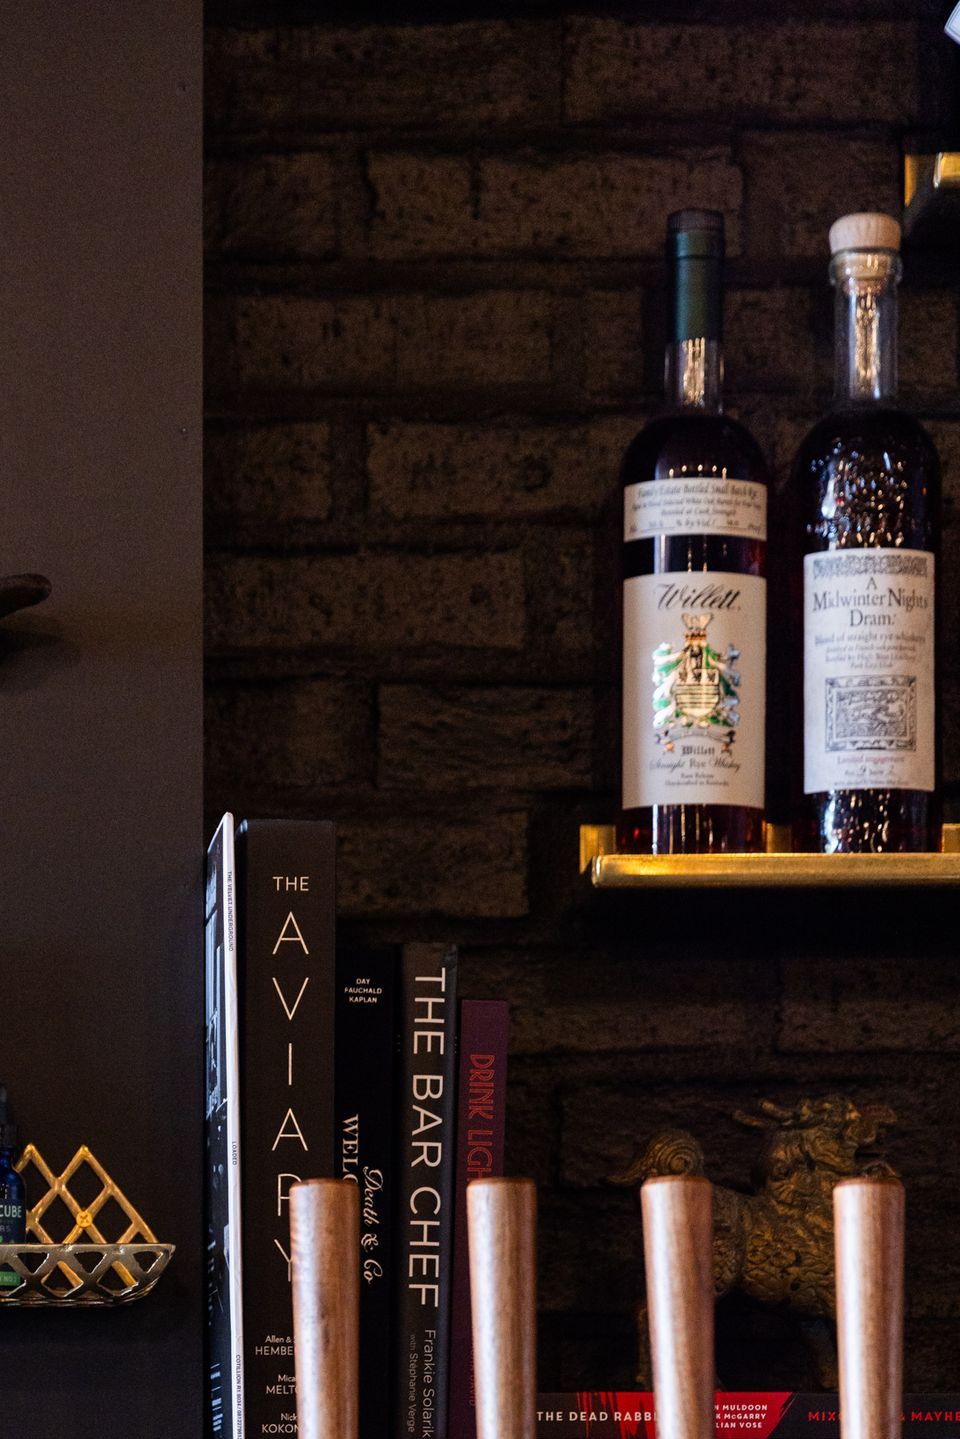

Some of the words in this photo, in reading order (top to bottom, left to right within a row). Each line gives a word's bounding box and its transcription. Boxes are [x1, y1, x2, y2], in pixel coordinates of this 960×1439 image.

[654, 583, 740, 611] Willett
[866, 577, 877, 590] A
[813, 589, 887, 612] Midwinter
[888, 587, 929, 613] Nights
[273, 876, 310, 892] THE
[344, 986, 383, 995] FAUCHALD
[348, 995, 378, 1004] KAPLAN
[413, 967, 446, 1055] THE
[468, 1053, 496, 1120] DRINK
[410, 1074, 444, 1168] BAR
[361, 1165, 384, 1226] Death
[360, 1232, 379, 1253] &
[407, 1186, 441, 1308] CHEF
[265, 1335, 285, 1343] Allen
[421, 1329, 437, 1384] Frankie
[407, 1404, 417, 1433] Verge
[421, 1389, 435, 1439] Solarik
[537, 1411, 564, 1422] THE
[569, 1411, 609, 1422] DEAD
